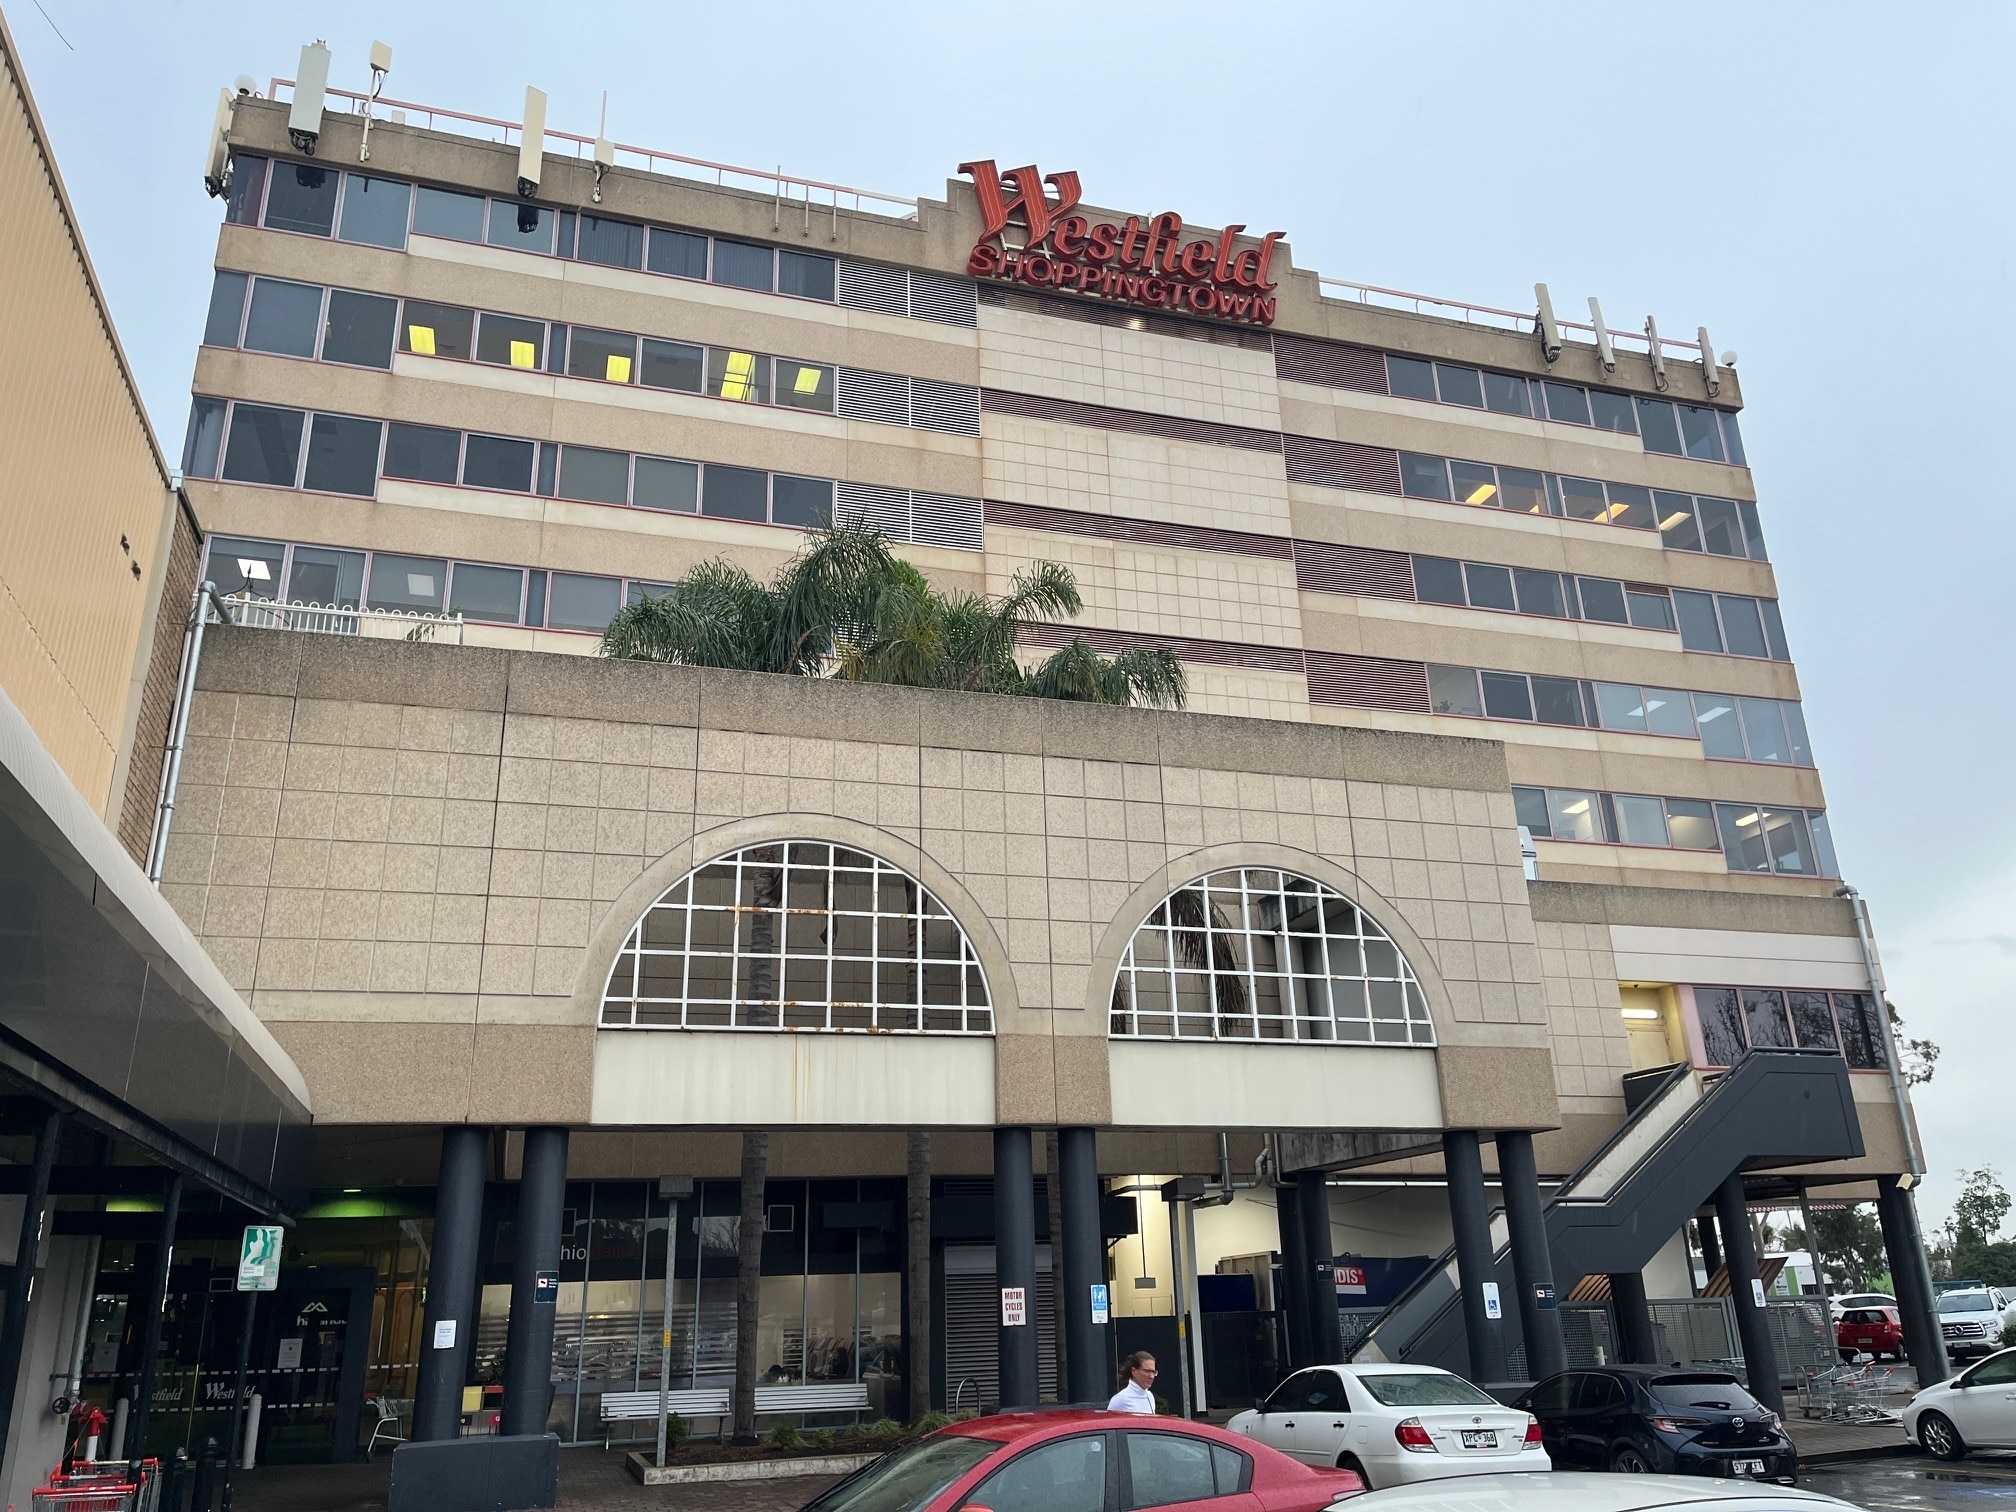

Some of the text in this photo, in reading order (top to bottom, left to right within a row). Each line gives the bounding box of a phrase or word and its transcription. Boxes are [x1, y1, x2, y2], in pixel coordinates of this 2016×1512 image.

[957, 159, 1287, 294] Westfield
[966, 244, 1277, 326] SHOPPINGTOWN
[1004, 1291, 1023, 1300] MOTOR
[1005, 1302, 1023, 1312] CYCLES
[1008, 1313, 1020, 1322] ONLY
